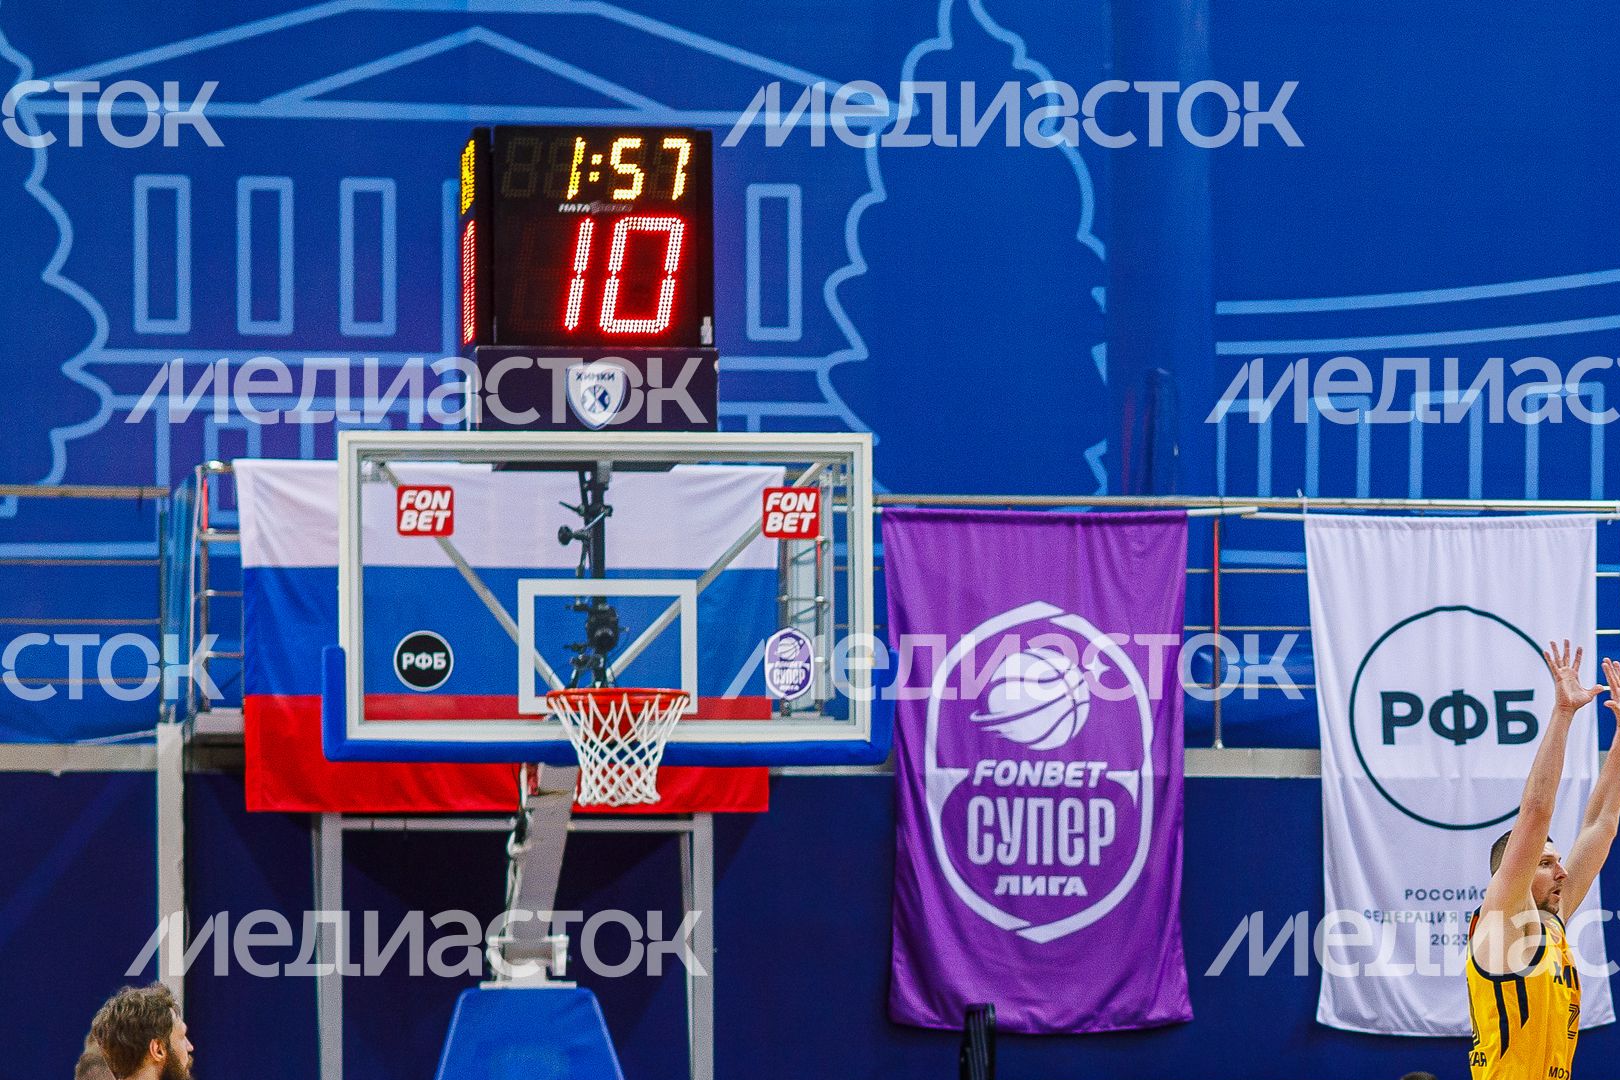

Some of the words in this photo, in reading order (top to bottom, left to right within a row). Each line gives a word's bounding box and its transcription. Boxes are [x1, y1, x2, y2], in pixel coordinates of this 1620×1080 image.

[566, 136, 692, 201] 1:57
[563, 217, 686, 335] 10
[400, 489, 450, 510] FON
[766, 491, 816, 511] FON
[399, 511, 450, 532] BET
[765, 512, 816, 534] BET
[402, 653, 448, 671] РФБ
[1380, 688, 1540, 747] РФБ
[973, 759, 1108, 788] FONBET
[993, 874, 1089, 897] ЛИГА
